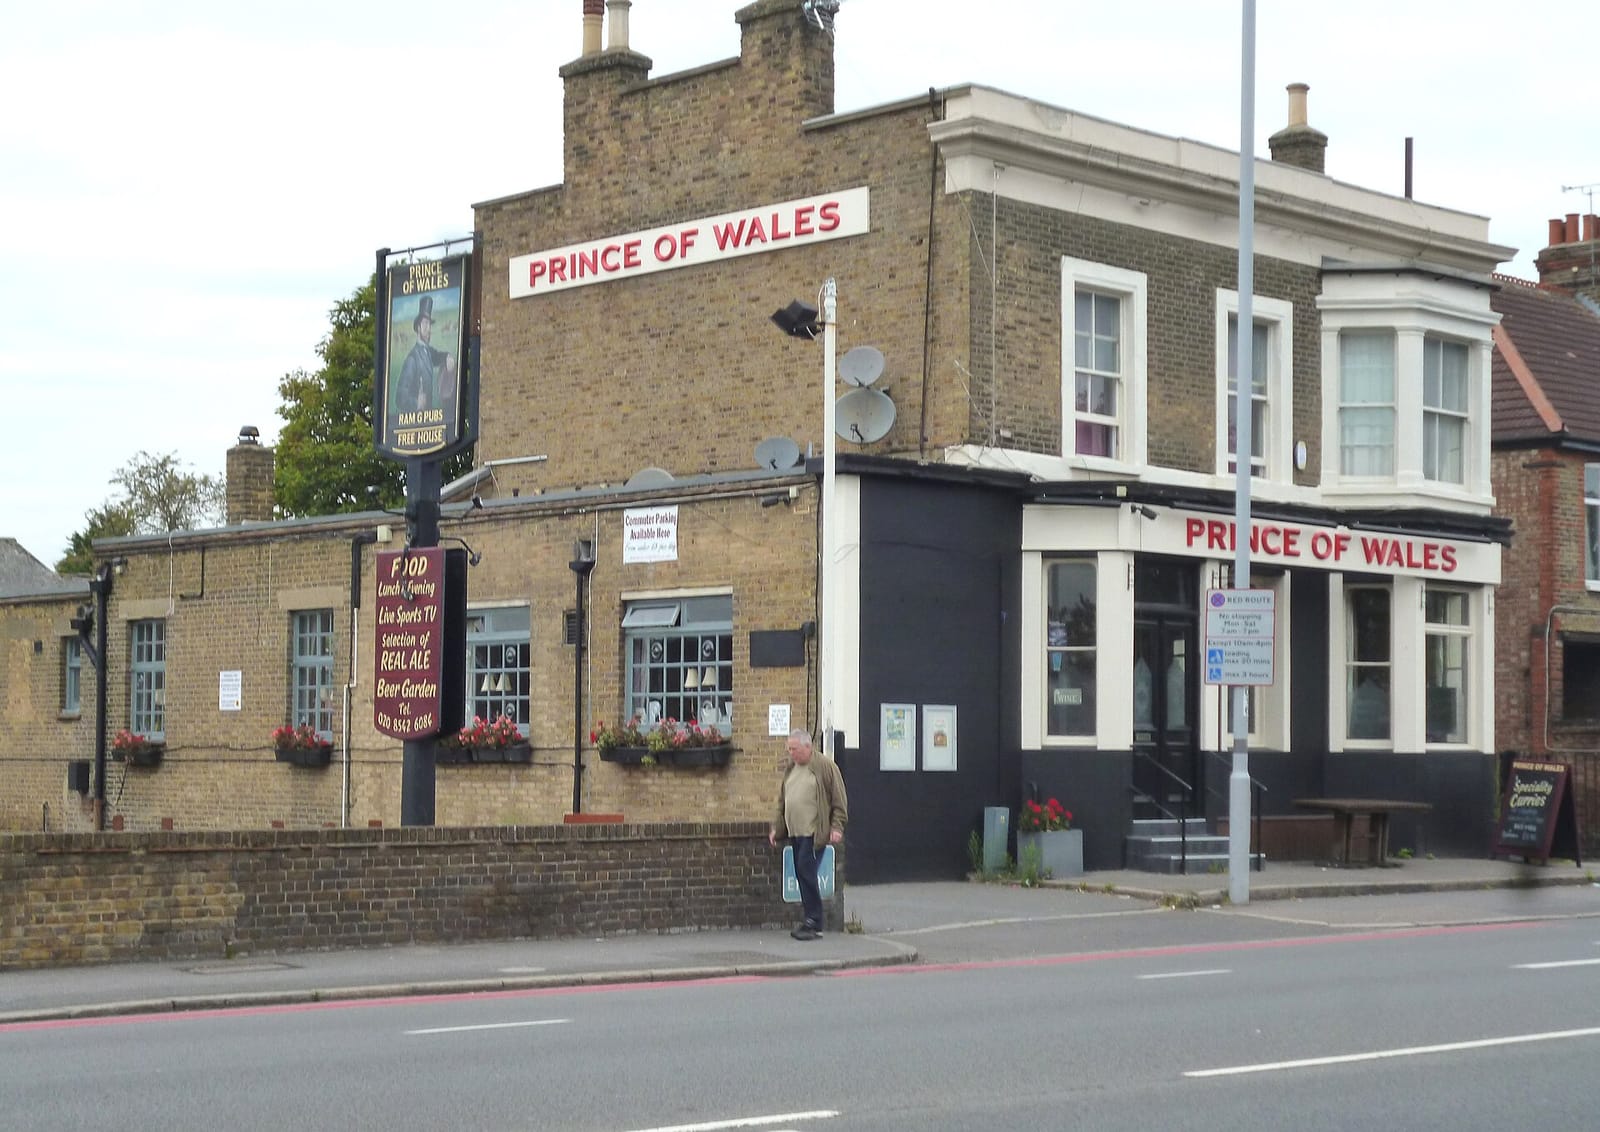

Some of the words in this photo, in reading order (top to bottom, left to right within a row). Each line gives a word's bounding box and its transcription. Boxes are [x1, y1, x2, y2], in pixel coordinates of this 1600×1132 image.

[529, 240, 642, 288] PRINCE
[653, 228, 699, 262] OF
[712, 201, 841, 251] WALES
[409, 262, 442, 280] PRINCE
[402, 280, 415, 294] OF
[416, 273, 449, 292] WALES
[398, 412, 416, 425] RAM
[417, 411, 423, 424] G
[423, 408, 443, 423] PUBS
[397, 430, 415, 446] FREE
[417, 428, 443, 444] HOUSE
[1311, 532, 1352, 561] OF
[1361, 536, 1458, 573] WALES
[378, 580, 400, 598] Lunch
[407, 579, 436, 598] Evening
[1227, 596, 1243, 604] RED
[1245, 596, 1271, 604] ROUTE
[378, 605, 395, 625] Live
[396, 604, 422, 629] Sports
[423, 604, 438, 623] TV
[382, 631, 416, 648] Selection
[419, 630, 430, 649] of
[381, 650, 407, 671] REAL
[409, 649, 432, 671] ALE
[377, 678, 400, 698] Beer
[402, 678, 437, 698] Garden
[398, 701, 412, 716] Tel.
[378, 711, 391, 730] 020
[393, 717, 411, 734] 8542
[1510, 794, 1546, 808] Curries
